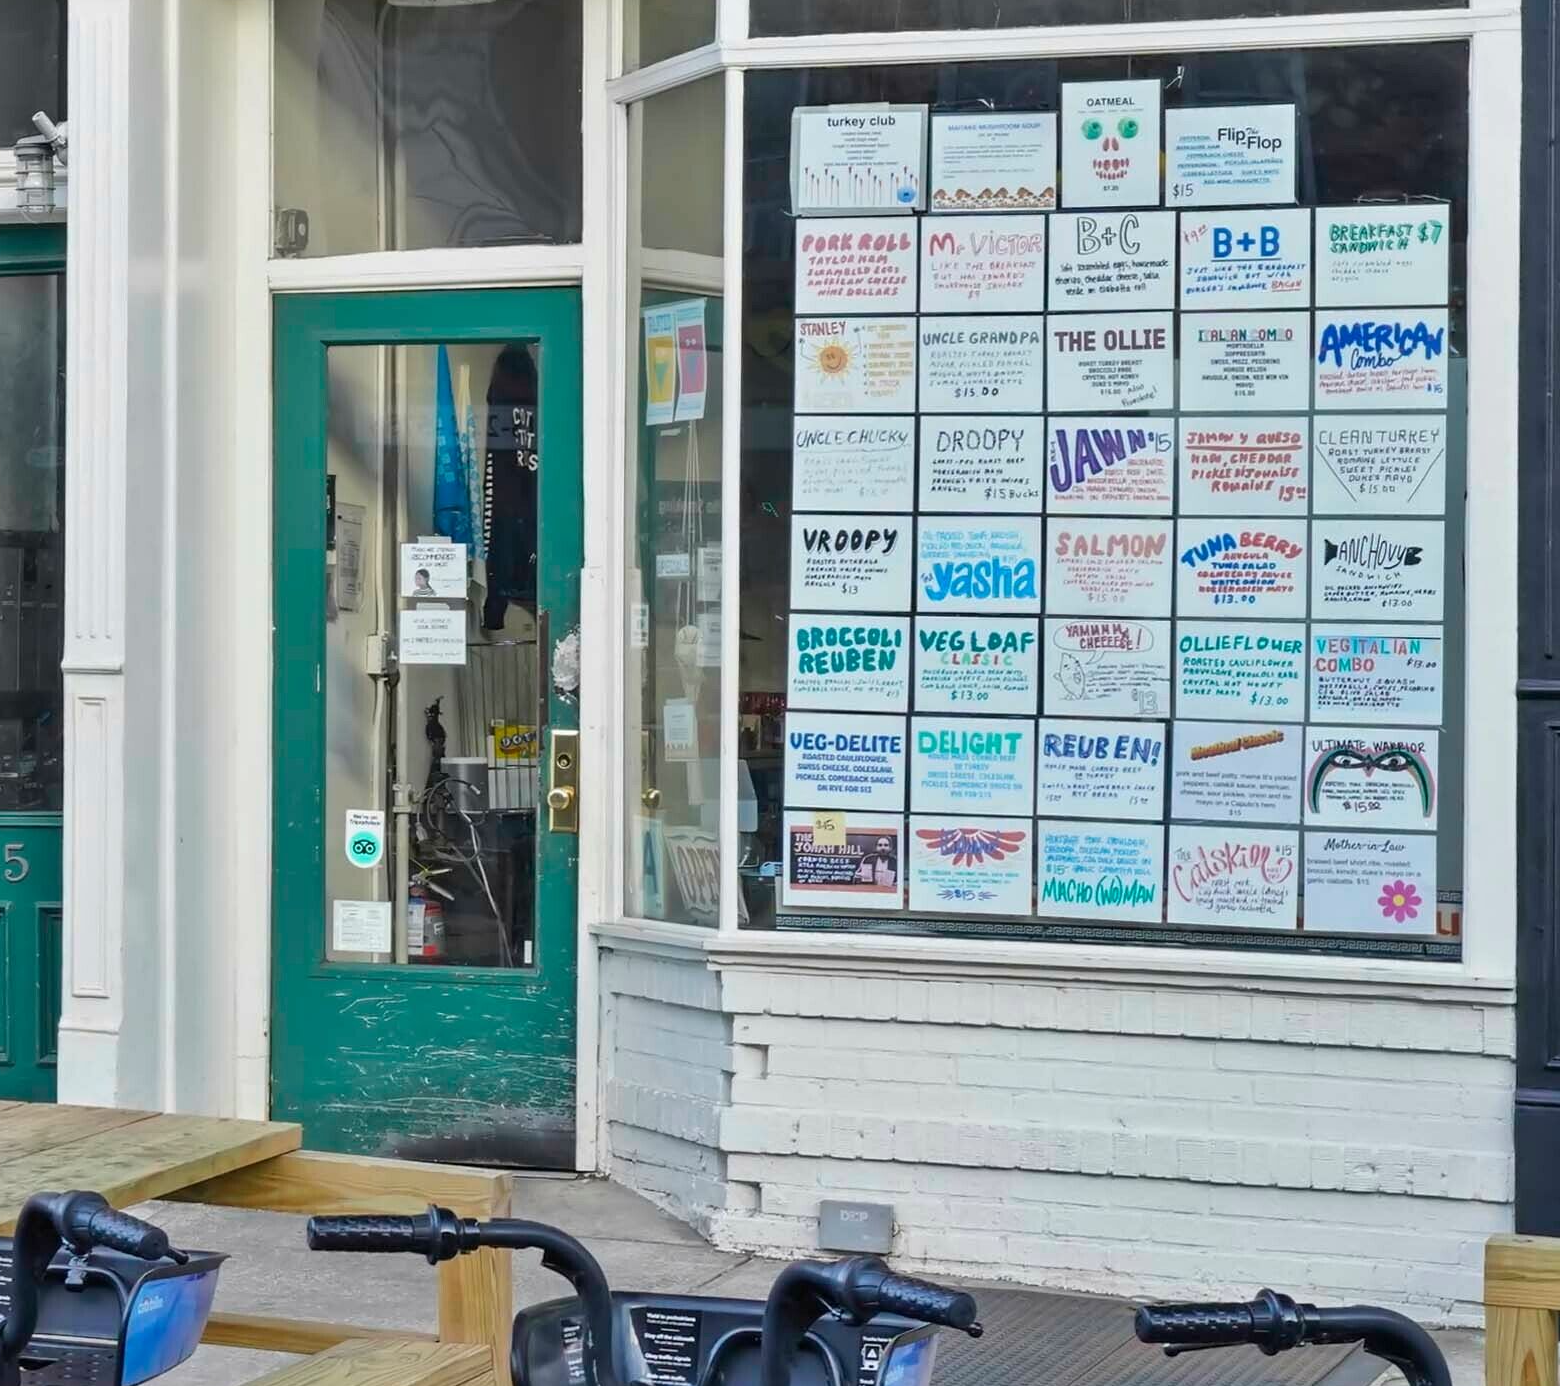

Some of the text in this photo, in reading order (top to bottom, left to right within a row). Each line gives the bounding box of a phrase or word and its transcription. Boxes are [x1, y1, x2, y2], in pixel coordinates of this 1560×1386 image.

[1086, 97, 1135, 107] OATMEAL
[827, 116, 896, 127] turkey club
[1218, 127, 1246, 145] Flip
[1172, 183, 1194, 198] $15
[802, 233, 911, 252] PORK ROLL
[970, 231, 1043, 255] VICTOR
[1077, 214, 1140, 255] B+C
[1213, 226, 1281, 258] B+B
[1330, 220, 1443, 245] BREAKFAST $7
[1330, 238, 1409, 254] SANDWICH
[800, 321, 846, 336] STANLEY
[923, 331, 1040, 346] UNCLE GRANDPA
[1054, 329, 1166, 352] THE OLLIE
[1318, 321, 1444, 367] AMERICAN
[1351, 348, 1402, 370] Combo
[797, 429, 908, 448] UNCLE CHUCKY
[936, 429, 1024, 452] DROOPY
[1187, 432, 1302, 445] JAMON Y QUESO
[1319, 429, 1440, 445] CLEAN TURKEY
[1050, 429, 1146, 493] JAWN
[1329, 448, 1358, 456] ROAST
[1363, 447, 1397, 455] TURKEY
[803, 528, 898, 554] VROOPY
[1055, 532, 1167, 558] SALMON
[1181, 532, 1302, 568] TUNA BERRY
[1339, 533, 1407, 570] ANCHOVY
[841, 583, 858, 595] $13
[925, 556, 1037, 601] yasha
[796, 627, 902, 651] BROCCOLI
[919, 629, 1035, 653] VEG LOAF
[1180, 636, 1302, 654] OLLIEFLOWER
[1317, 639, 1421, 654] VEGITALIAN
[798, 648, 896, 674] REUBEN
[941, 653, 1013, 665] CLASSIC
[1314, 658, 1374, 672] COMBO
[790, 732, 901, 754] VEG-DELITE
[917, 730, 1023, 755] DELIGHT
[1044, 733, 1162, 766] REUBEN!
[1312, 740, 1426, 753] ULTIMATE WARRIOR
[794, 843, 864, 855] JONAH HILL
[1324, 838, 1406, 853] Mother-in-Law
[1042, 879, 1092, 903] MACHO
